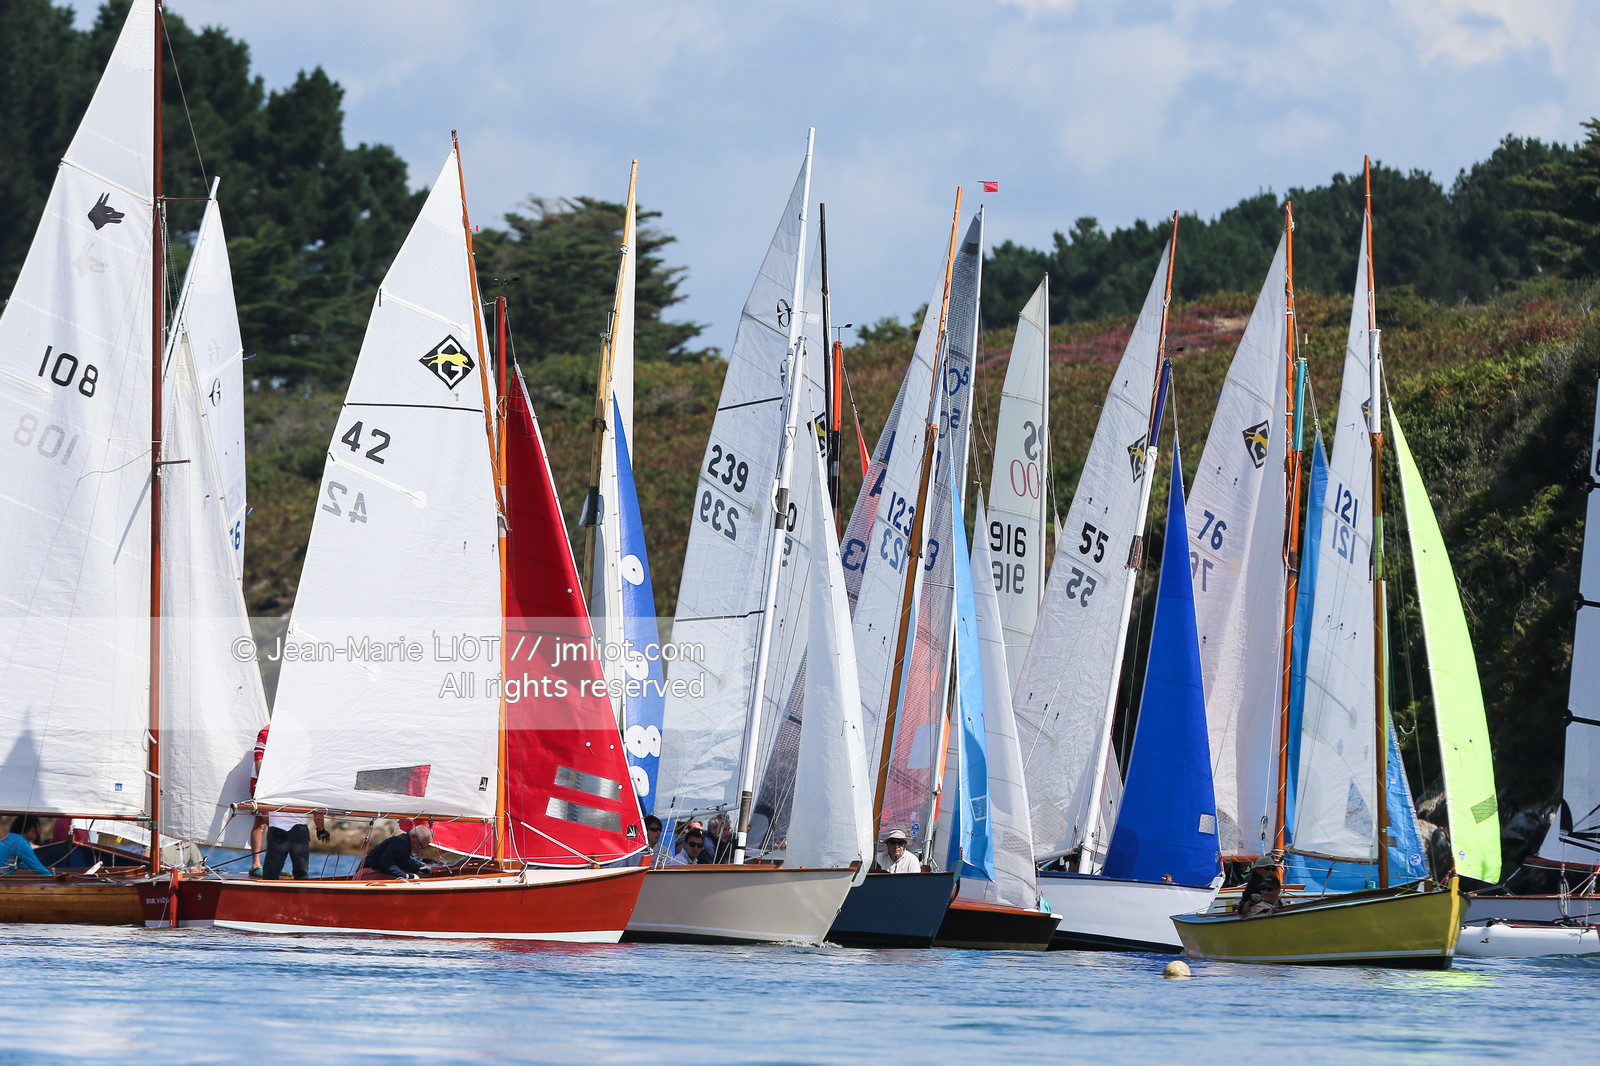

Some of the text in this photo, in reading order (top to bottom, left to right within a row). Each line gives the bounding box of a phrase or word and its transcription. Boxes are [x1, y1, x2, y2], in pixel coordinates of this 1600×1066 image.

[38, 345, 98, 398] 108
[341, 420, 391, 464] 42
[707, 444, 749, 493] 239
[887, 491, 915, 537] 123
[1334, 483, 1358, 529] 121
[990, 521, 1026, 558] 916
[1078, 521, 1109, 564] 55
[1197, 510, 1227, 550] 76
